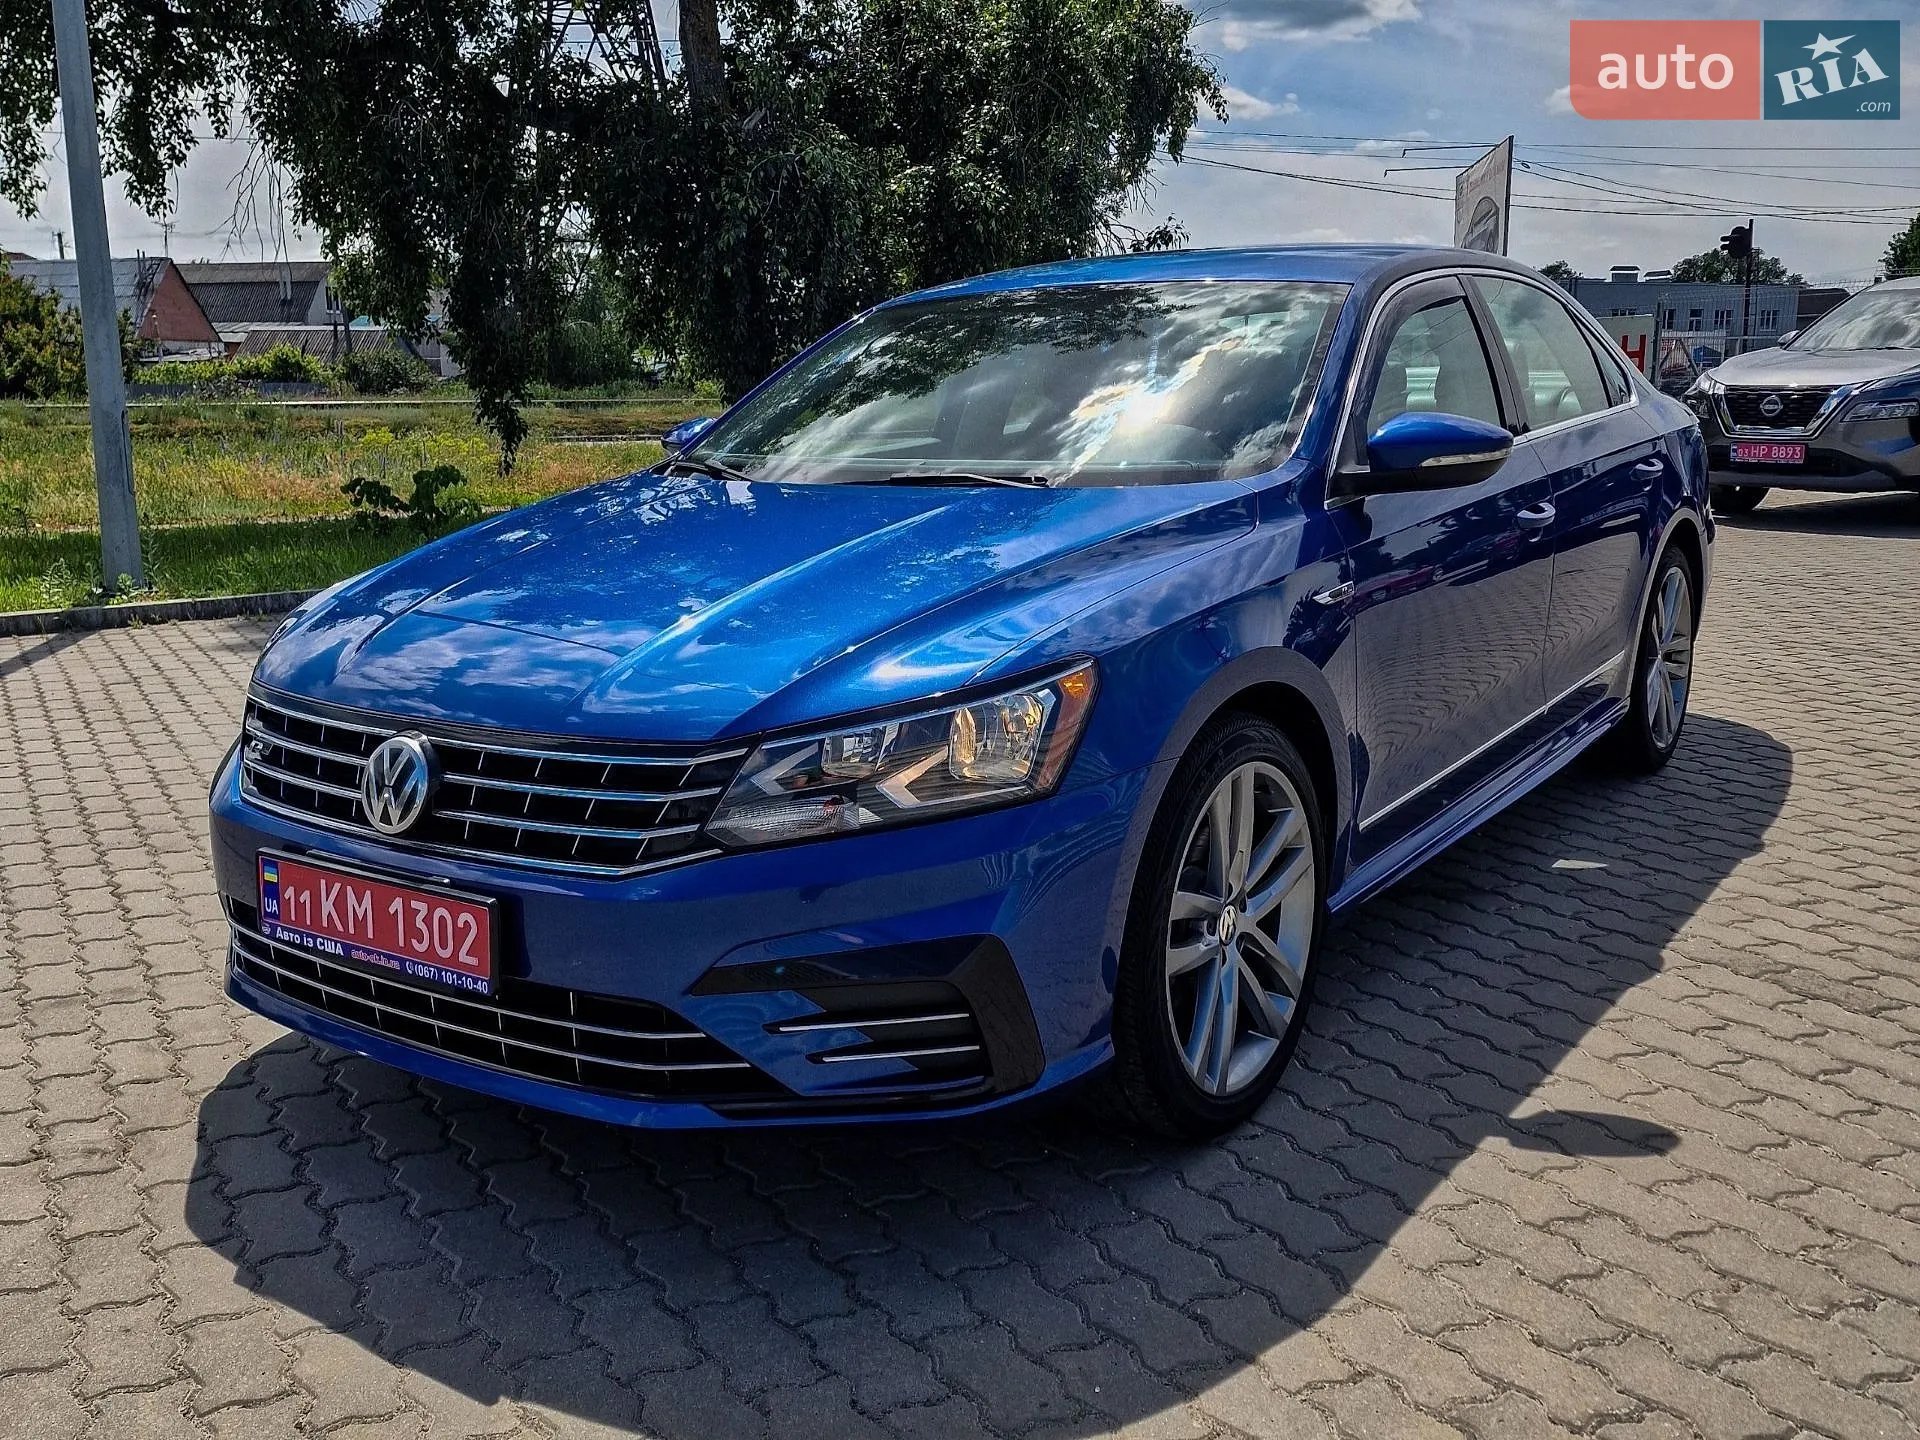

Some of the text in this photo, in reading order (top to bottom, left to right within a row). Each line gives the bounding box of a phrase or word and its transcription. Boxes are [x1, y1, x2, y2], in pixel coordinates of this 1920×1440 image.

[1751, 446, 1768, 458] HP
[1771, 446, 1801, 459] 8893
[264, 897, 279, 915] UA
[284, 879, 479, 967] 11 KM 1302
[276, 926, 301, 943] Авто
[316, 938, 344, 956] США
[415, 964, 488, 994] (067) 101-10-40
